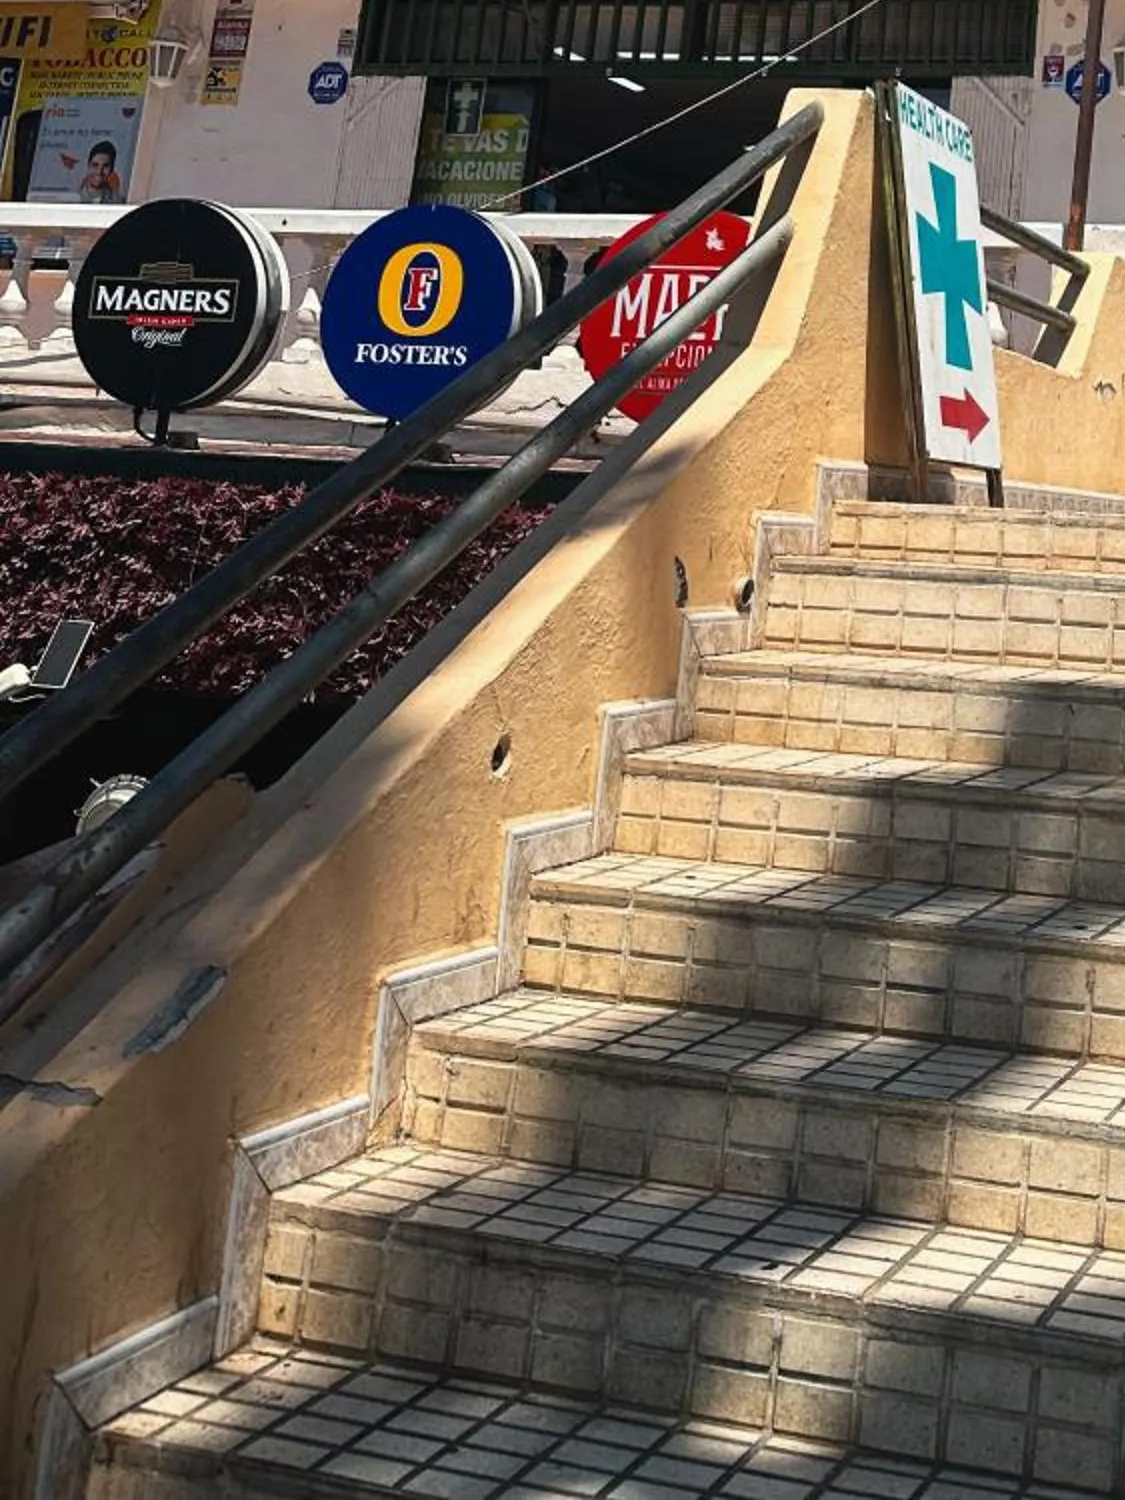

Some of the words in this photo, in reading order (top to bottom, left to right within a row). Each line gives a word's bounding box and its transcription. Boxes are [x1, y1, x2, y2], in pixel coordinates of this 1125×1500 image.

[314, 73, 342, 89] ADT
[900, 90, 945, 147] HEALTH
[945, 118, 972, 163] CARE
[96, 285, 231, 314] MAGNERS
[131, 326, 187, 348] Original
[354, 343, 467, 366] FOSTER'S
